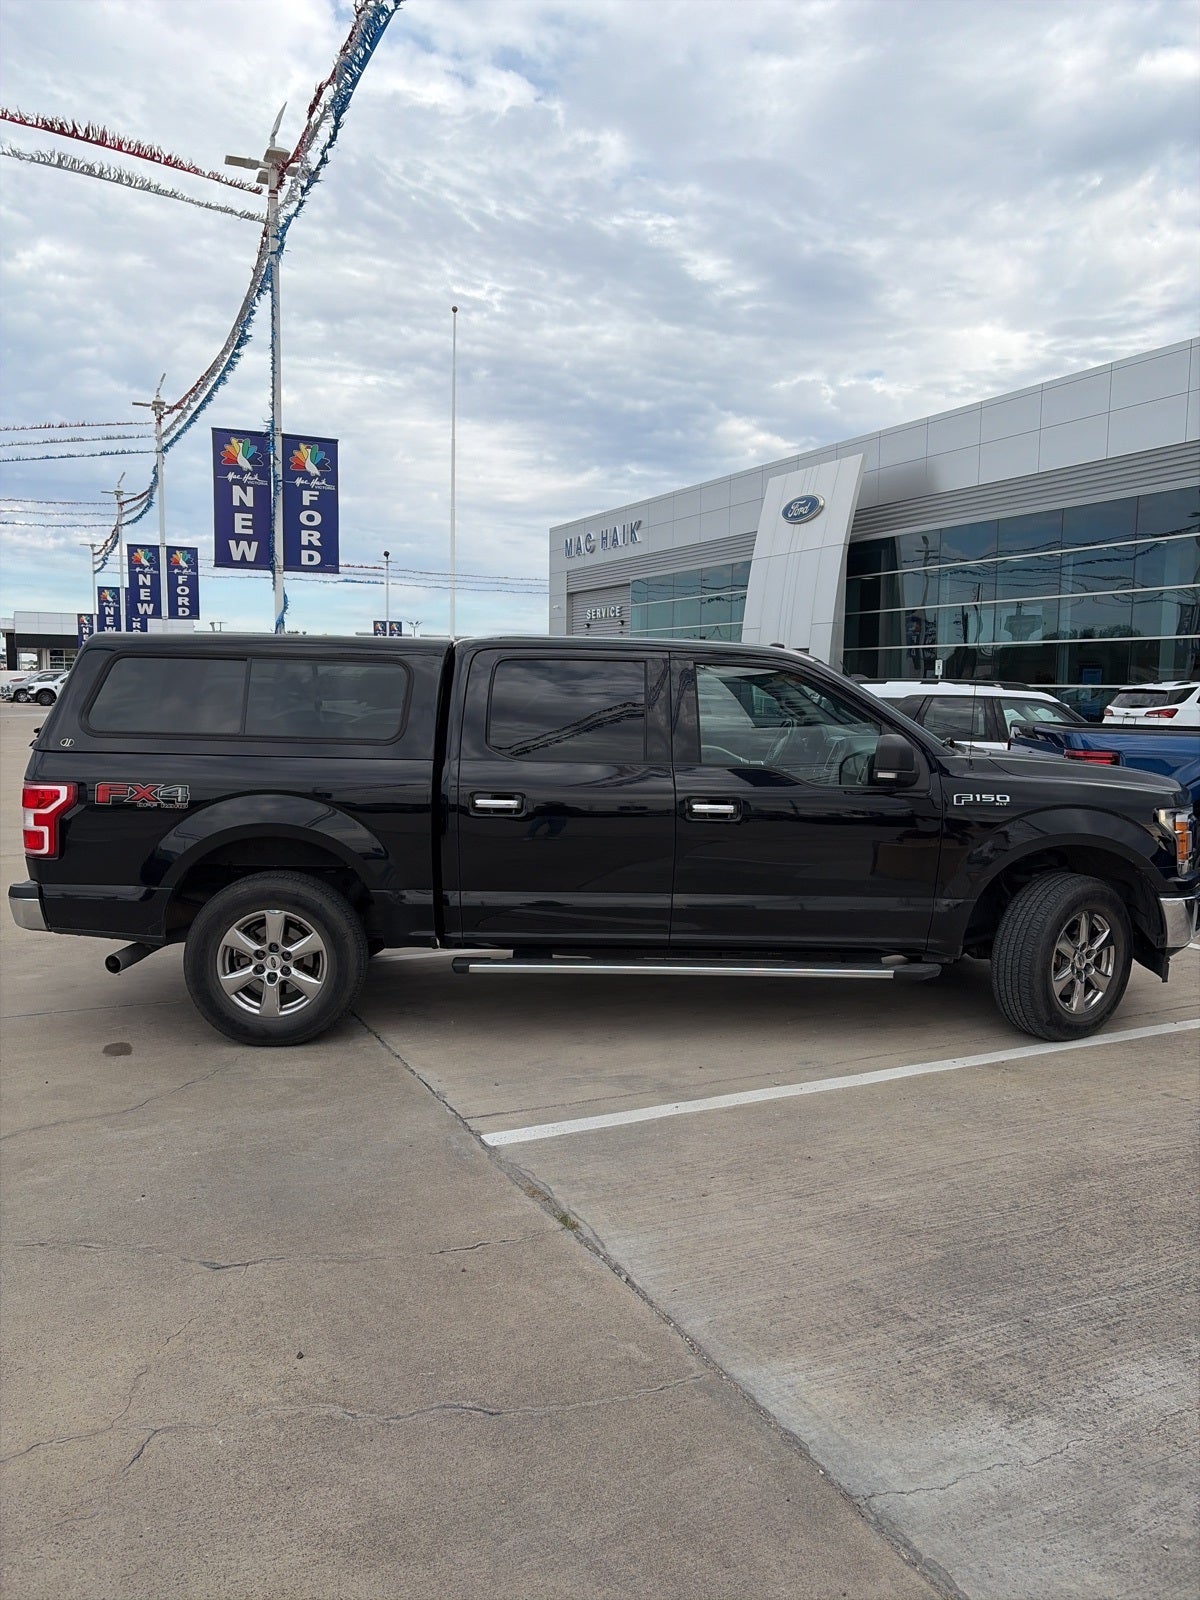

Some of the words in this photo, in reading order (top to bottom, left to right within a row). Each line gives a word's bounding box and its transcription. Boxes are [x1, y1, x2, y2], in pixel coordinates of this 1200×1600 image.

[228, 485, 258, 562] NEW
[299, 490, 322, 566] FORD
[790, 500, 811, 517] Ford
[564, 532, 596, 558] MAC
[601, 520, 642, 550] HAIK
[137, 574, 154, 615] NEW
[176, 575, 190, 616] FORD
[586, 606, 623, 620] SERVICE
[95, 782, 190, 804] FX4
